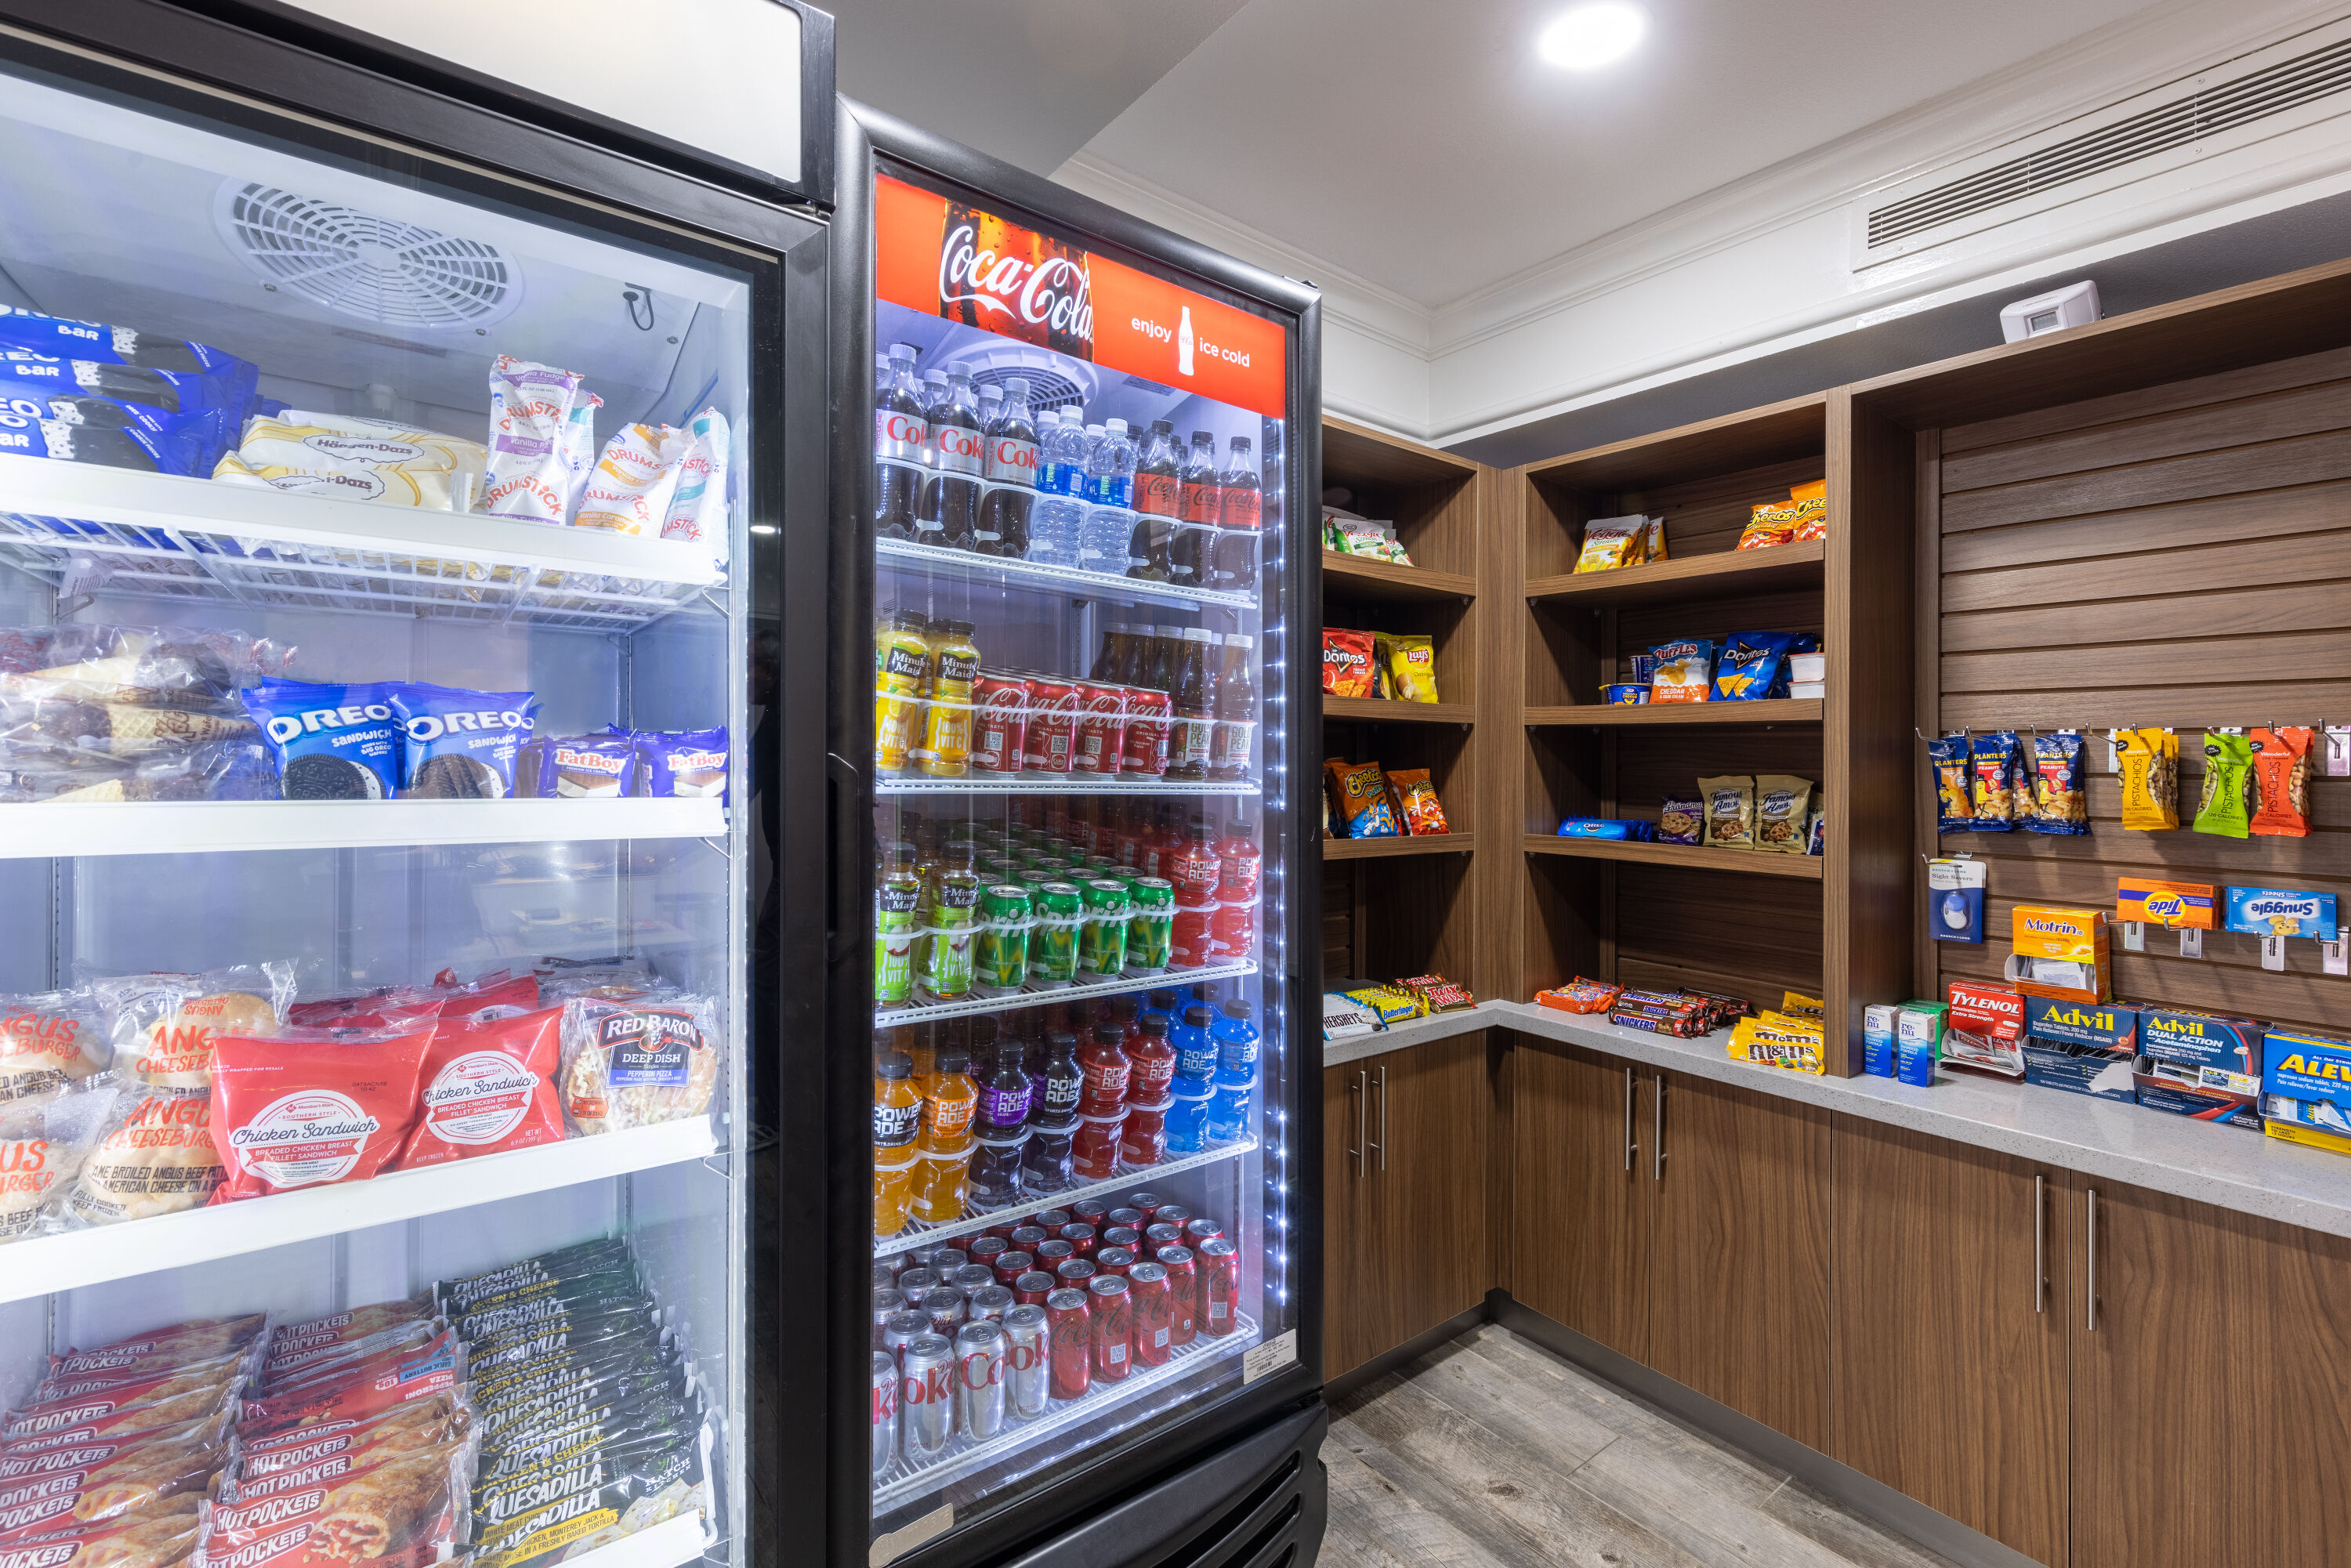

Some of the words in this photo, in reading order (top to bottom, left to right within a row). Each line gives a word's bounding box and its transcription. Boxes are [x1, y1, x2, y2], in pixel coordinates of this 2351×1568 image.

[940, 225, 1093, 344] Coca-Cola
[1131, 316, 1172, 344] enjoy
[1199, 336, 1220, 357] ice
[1222, 347, 1250, 368] cold
[540, 371, 566, 380] Fudge
[510, 437, 538, 447] Vanilla
[1586, 528, 1632, 542] Veggie
[1324, 649, 1366, 664] Doritos
[1408, 650, 1429, 664] Lay's
[1654, 644, 1697, 664] RUFFLES
[1724, 647, 1770, 662] Doritos
[896, 662, 921, 675] Maid
[944, 665, 972, 679] Maid
[267, 705, 391, 744] OREO
[406, 712, 521, 741] OREO
[941, 721, 964, 733] 100%
[1232, 726, 1251, 738] GOLD
[940, 737, 955, 749] VIT
[956, 737, 962, 748] C
[1190, 733, 1211, 744] PEAK
[1230, 738, 1250, 749] PEAK
[557, 750, 621, 772] FatBoy
[1348, 770, 1382, 795] Cheetos
[2132, 759, 2143, 806] PISTACHIOS
[2221, 767, 2233, 813] PISTACHIOS
[2267, 761, 2280, 813] PISTACHIOS
[1366, 785, 1384, 797] Puffs
[1710, 790, 1742, 805] Famous
[1715, 801, 1740, 813] Amos
[1762, 792, 1795, 807] Famous
[1764, 802, 1791, 815] Amos
[1188, 870, 1211, 879] ADE
[1238, 866, 1256, 875] ADE
[2148, 898, 2183, 915] Tide
[2251, 902, 2314, 915] Snuggle
[2024, 918, 2078, 935] Motrin
[888, 970, 902, 982] VIT
[1951, 990, 2020, 1014] TYLENOL
[1383, 1005, 1414, 1019] Butterfinger
[1643, 1006, 1668, 1016] SNICKERS
[2041, 1005, 2114, 1031] Advil
[1324, 1012, 1363, 1029] HERSHEY'S
[1615, 1015, 1656, 1031] SNICKERS
[2147, 1017, 2204, 1036] Advil
[607, 1018, 645, 1041] RED
[645, 1015, 697, 1044] BARON
[1901, 1028, 1914, 1037] nu
[2146, 1030, 2177, 1040] DUAL
[2179, 1035, 2224, 1048] ACTION
[2154, 1037, 2221, 1054] Acetaminophen
[622, 1053, 654, 1063] DEEP
[654, 1054, 681, 1063] DISH
[1183, 1059, 1205, 1069] ADE
[1149, 1068, 1171, 1080] ADE
[2278, 1054, 2351, 1082] ALEV
[13, 1071, 46, 1086] ANGUS
[1102, 1075, 1123, 1088] ADE
[17, 1081, 55, 1099] CHEESE
[423, 1087, 471, 1105] Chicken
[474, 1074, 538, 1095] Sandwich
[1045, 1091, 1075, 1103] ADE
[438, 1103, 466, 1114] BREADED
[468, 1099, 495, 1108] CHICKEN
[473, 1103, 507, 1113] SANDWICH
[998, 1100, 1023, 1112] ADE
[937, 1111, 965, 1123] ADE
[234, 1128, 299, 1145] Chicken
[302, 1119, 377, 1139] Sandwich
[255, 1147, 291, 1157] BREADED
[292, 1144, 325, 1153] CHICKEN
[328, 1141, 353, 1150] BREAST
[298, 1150, 337, 1160] SANDWICH
[112, 1166, 152, 1179] BROILED
[152, 1167, 184, 1179] ANGUS
[186, 1166, 207, 1179] BEEF
[103, 1181, 149, 1193] AMERICAN
[150, 1181, 187, 1193] CHEESE
[188, 1181, 201, 1192] ON
[519, 1278, 559, 1295] CHEESE
[931, 1314, 952, 1326] Diet
[429, 1374, 453, 1383] PIZZA
[405, 1381, 454, 1400] PEPPERONI
[554, 1434, 605, 1461] CHEESE
[538, 1537, 565, 1552] FRESHLY
[567, 1526, 587, 1539] BAKED
[588, 1515, 614, 1530] TORTILLA
[549, 1522, 581, 1537] MONTEREY
[583, 1515, 599, 1527] JACK
